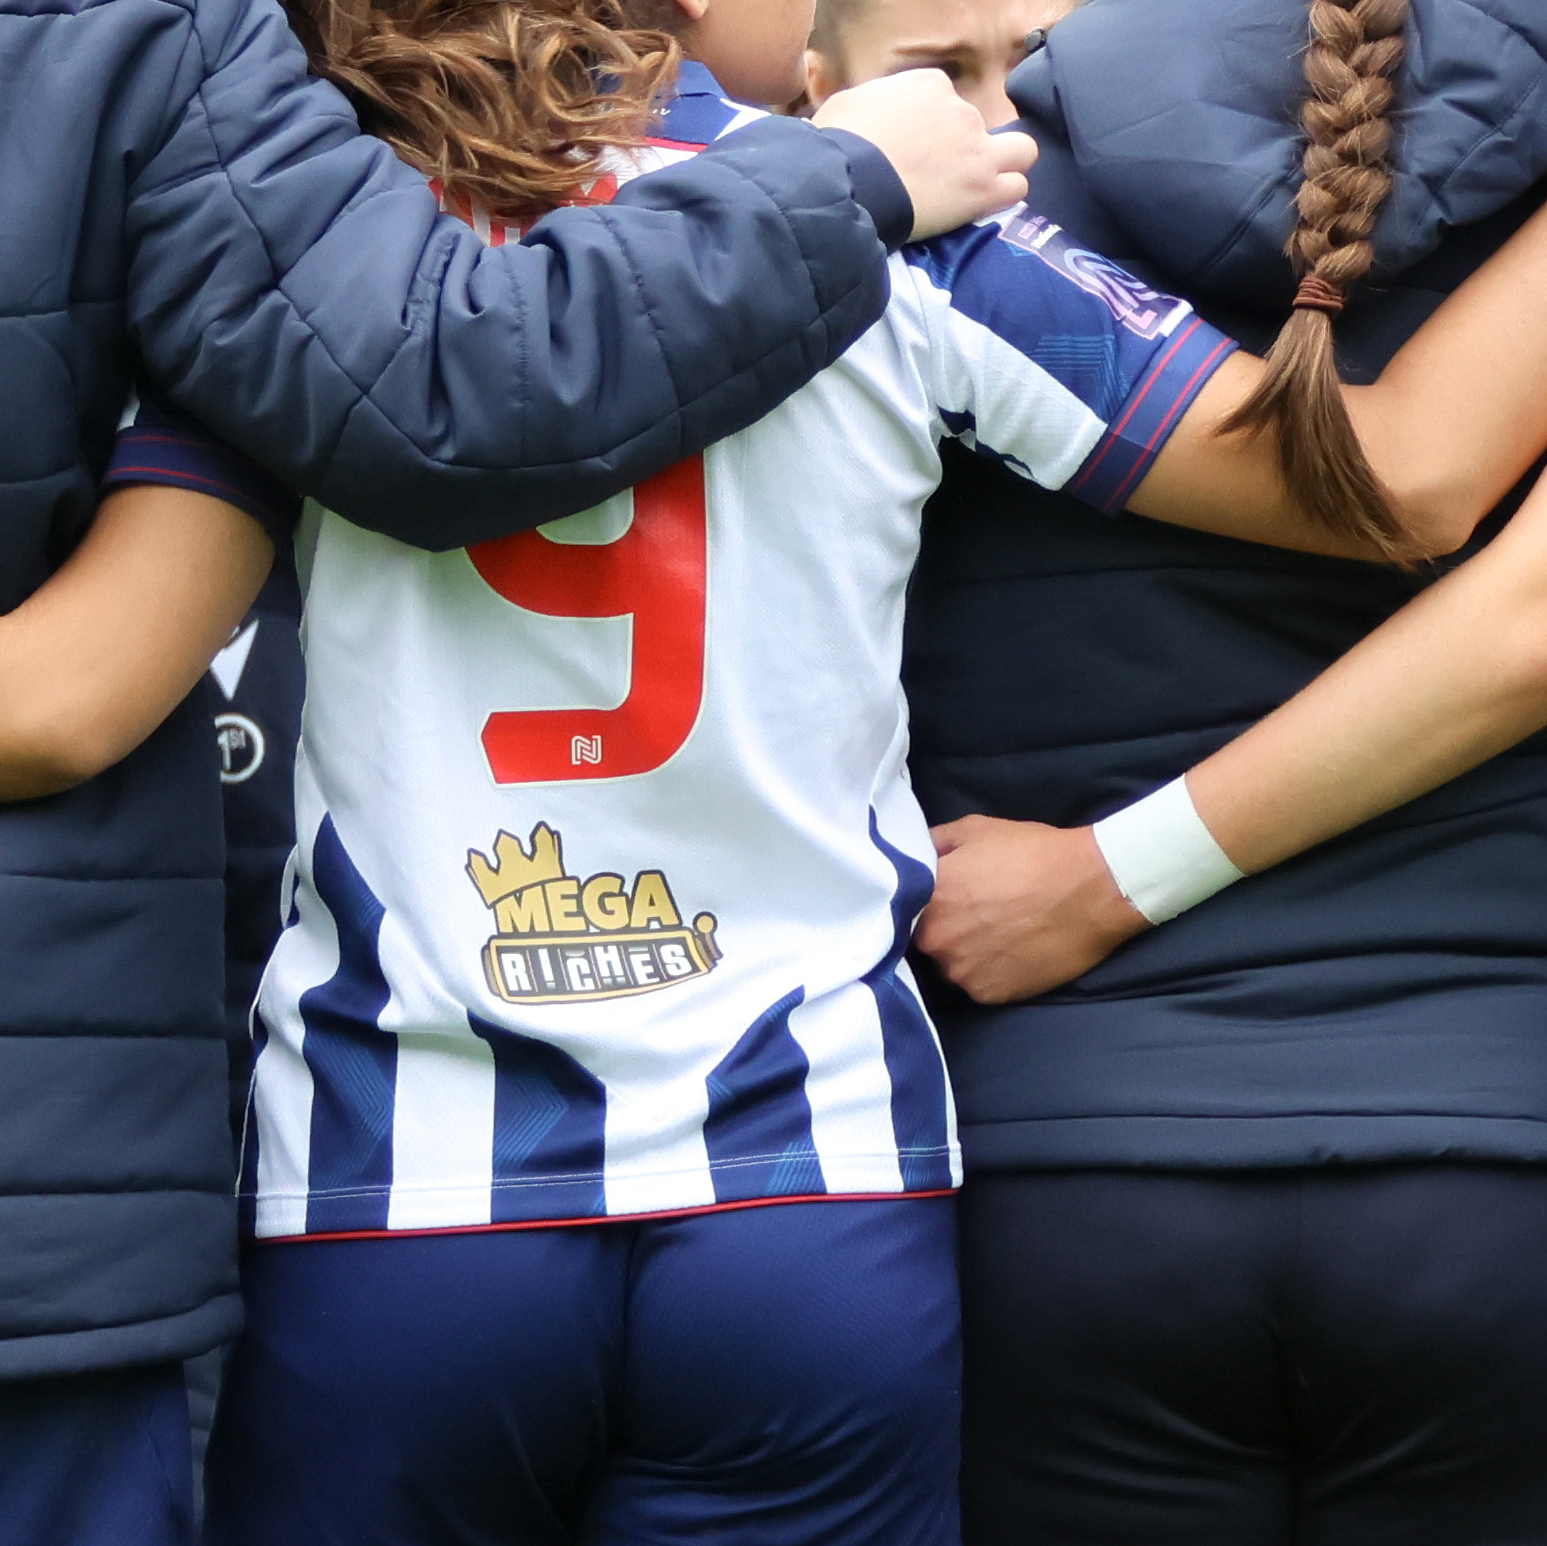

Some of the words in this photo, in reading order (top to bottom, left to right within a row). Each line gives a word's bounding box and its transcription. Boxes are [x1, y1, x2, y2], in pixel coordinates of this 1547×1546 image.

[461, 447, 708, 786] 9
[494, 869, 683, 935] MEGA
[500, 943, 694, 992] RICHES
